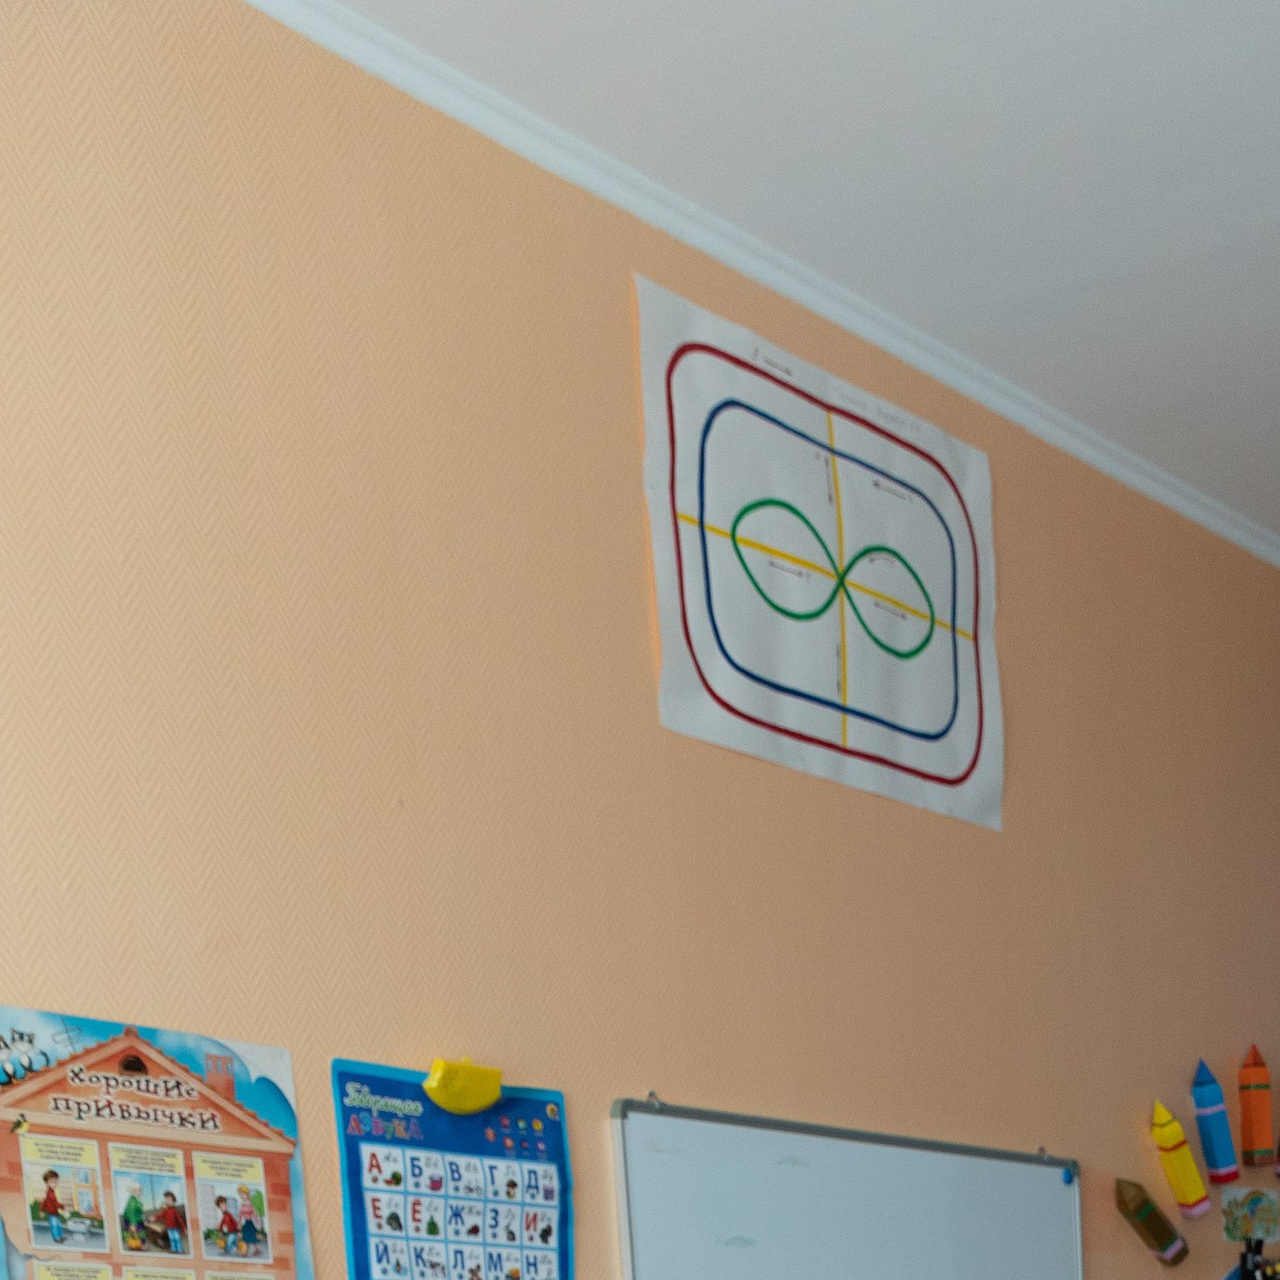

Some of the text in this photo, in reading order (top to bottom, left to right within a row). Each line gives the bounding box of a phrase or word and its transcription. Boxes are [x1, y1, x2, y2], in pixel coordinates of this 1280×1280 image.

[368, 1153, 382, 1174] А
[410, 1157, 422, 1177] Б
[449, 1161, 462, 1182] В
[489, 1165, 497, 1186] Г
[526, 1169, 539, 1194] Д
[371, 1198, 382, 1220] Е
[411, 1198, 421, 1222] Ё
[449, 1205, 464, 1226] Ж
[489, 1208, 499, 1228] З
[525, 1212, 538, 1232] И
[375, 1241, 538, 1275] Й К Л М Н
